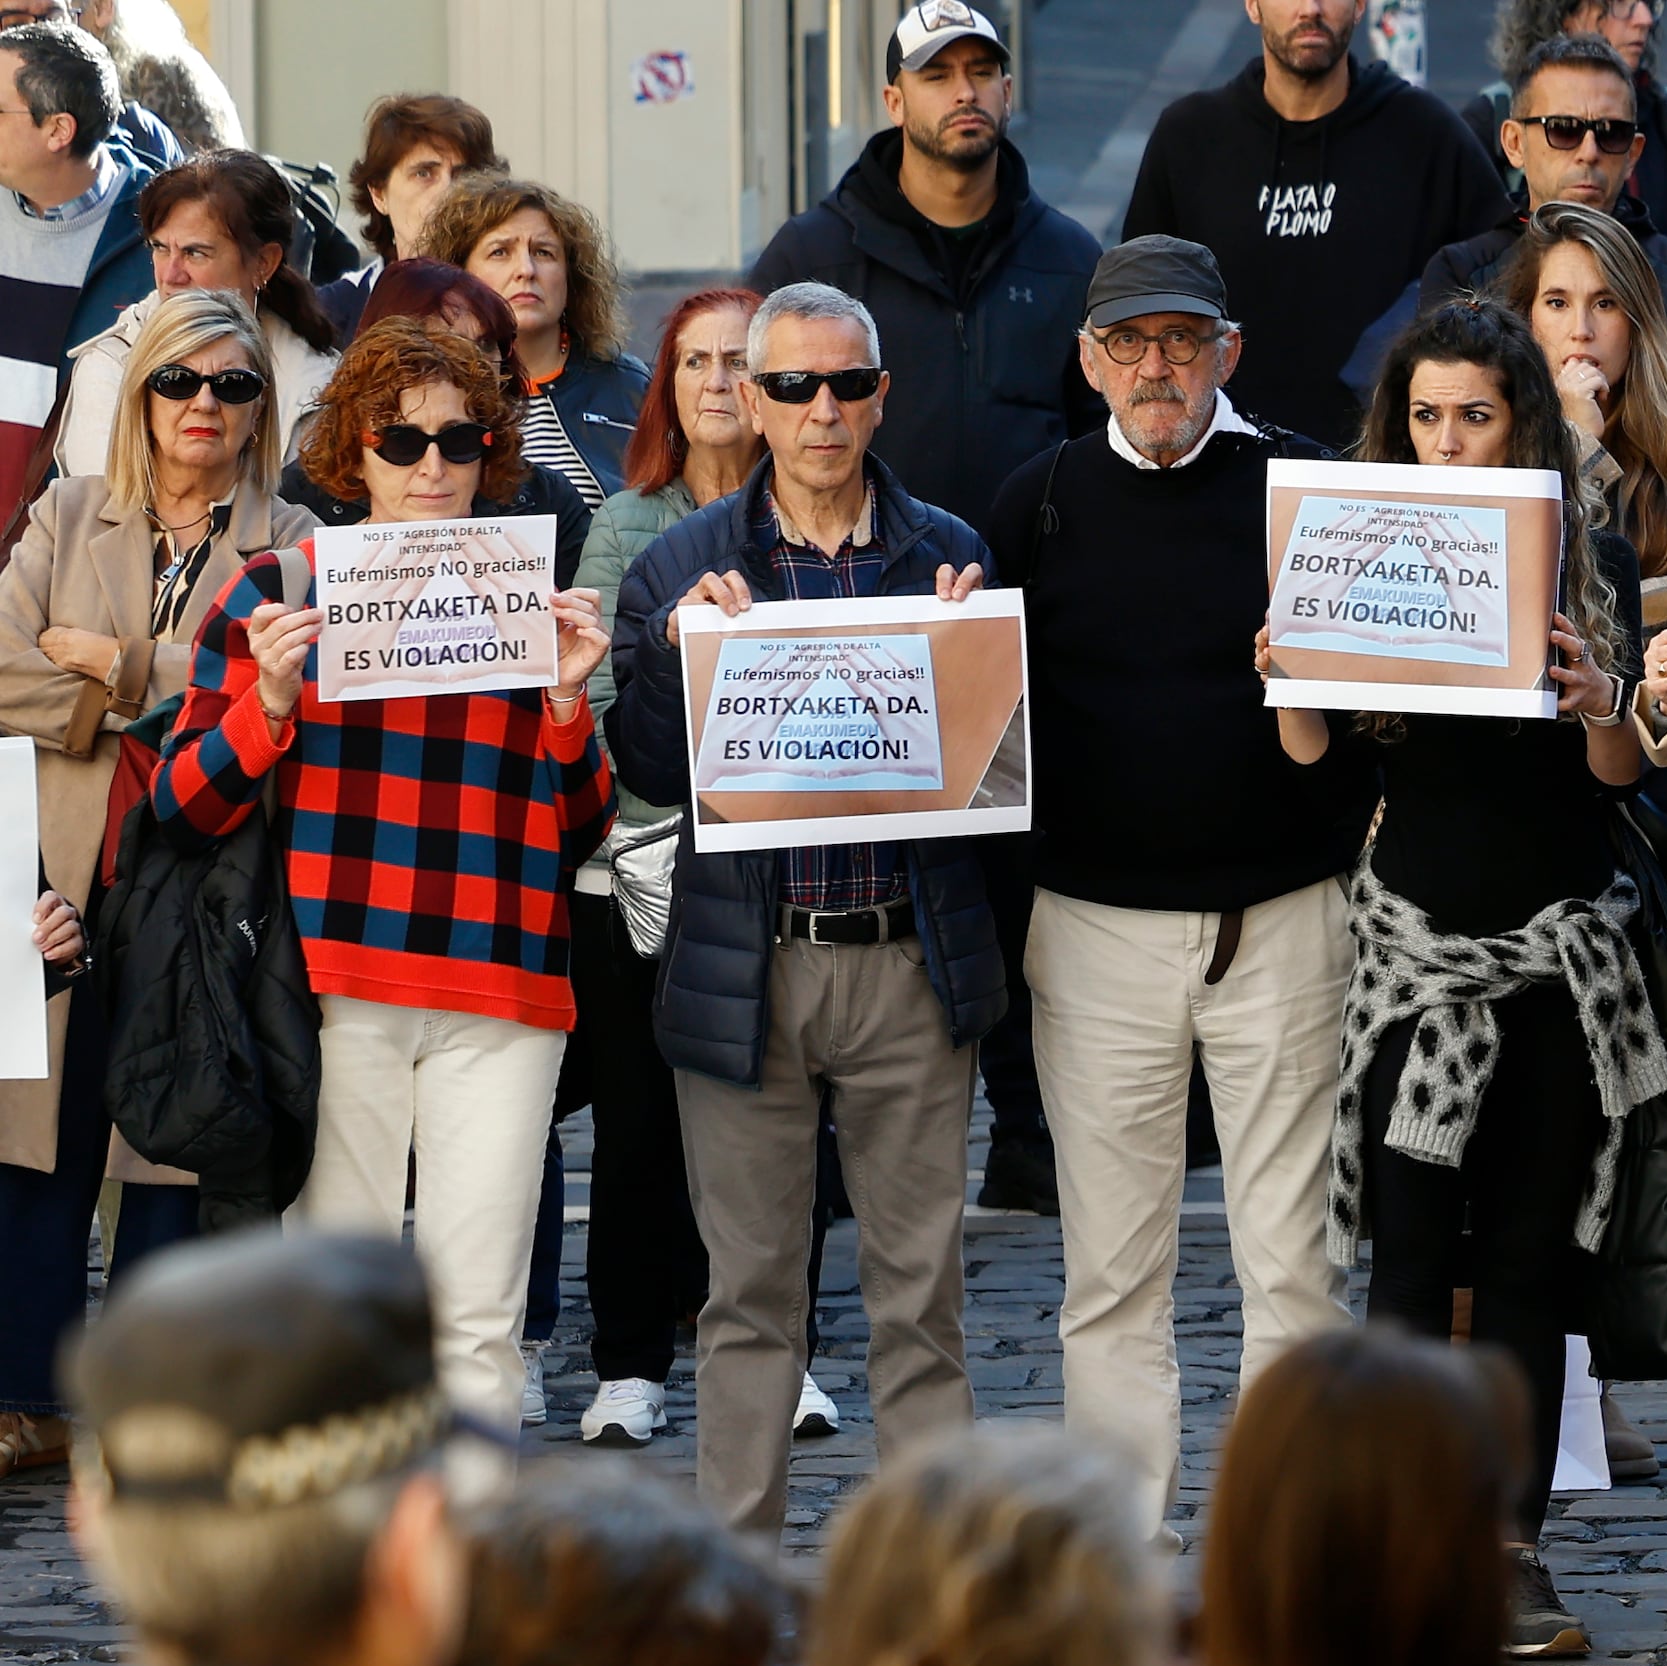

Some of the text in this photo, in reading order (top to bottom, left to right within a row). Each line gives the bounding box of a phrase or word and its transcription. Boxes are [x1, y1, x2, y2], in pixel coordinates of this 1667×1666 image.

[1259, 182, 1336, 211] PLATA O
[1266, 208, 1332, 237] PLOMO
[363, 533, 380, 541] NO
[383, 532, 394, 540] ES
[460, 527, 473, 536] DE
[476, 526, 502, 535] ALTA
[1300, 526, 1498, 553] Eufemismos NO gracias!!
[327, 557, 546, 583] Eufemismos NO gracias!!
[1290, 553, 1449, 585] BORTXAKETA
[1458, 569, 1499, 590] DA.
[328, 594, 497, 624] BORTXAKETA
[507, 592, 548, 613] DA.
[1292, 597, 1320, 617] ES
[1327, 600, 1476, 633] VIOLACIÓN!
[344, 651, 370, 670] ES
[379, 636, 527, 668] VIOLACIÓN!
[724, 668, 924, 682] Eufemismos NO gracias!!
[716, 697, 879, 715] BORTXAKETA
[887, 697, 928, 714] DA.
[724, 740, 751, 759] ES
[758, 736, 909, 760] VIOLACIÓN!
